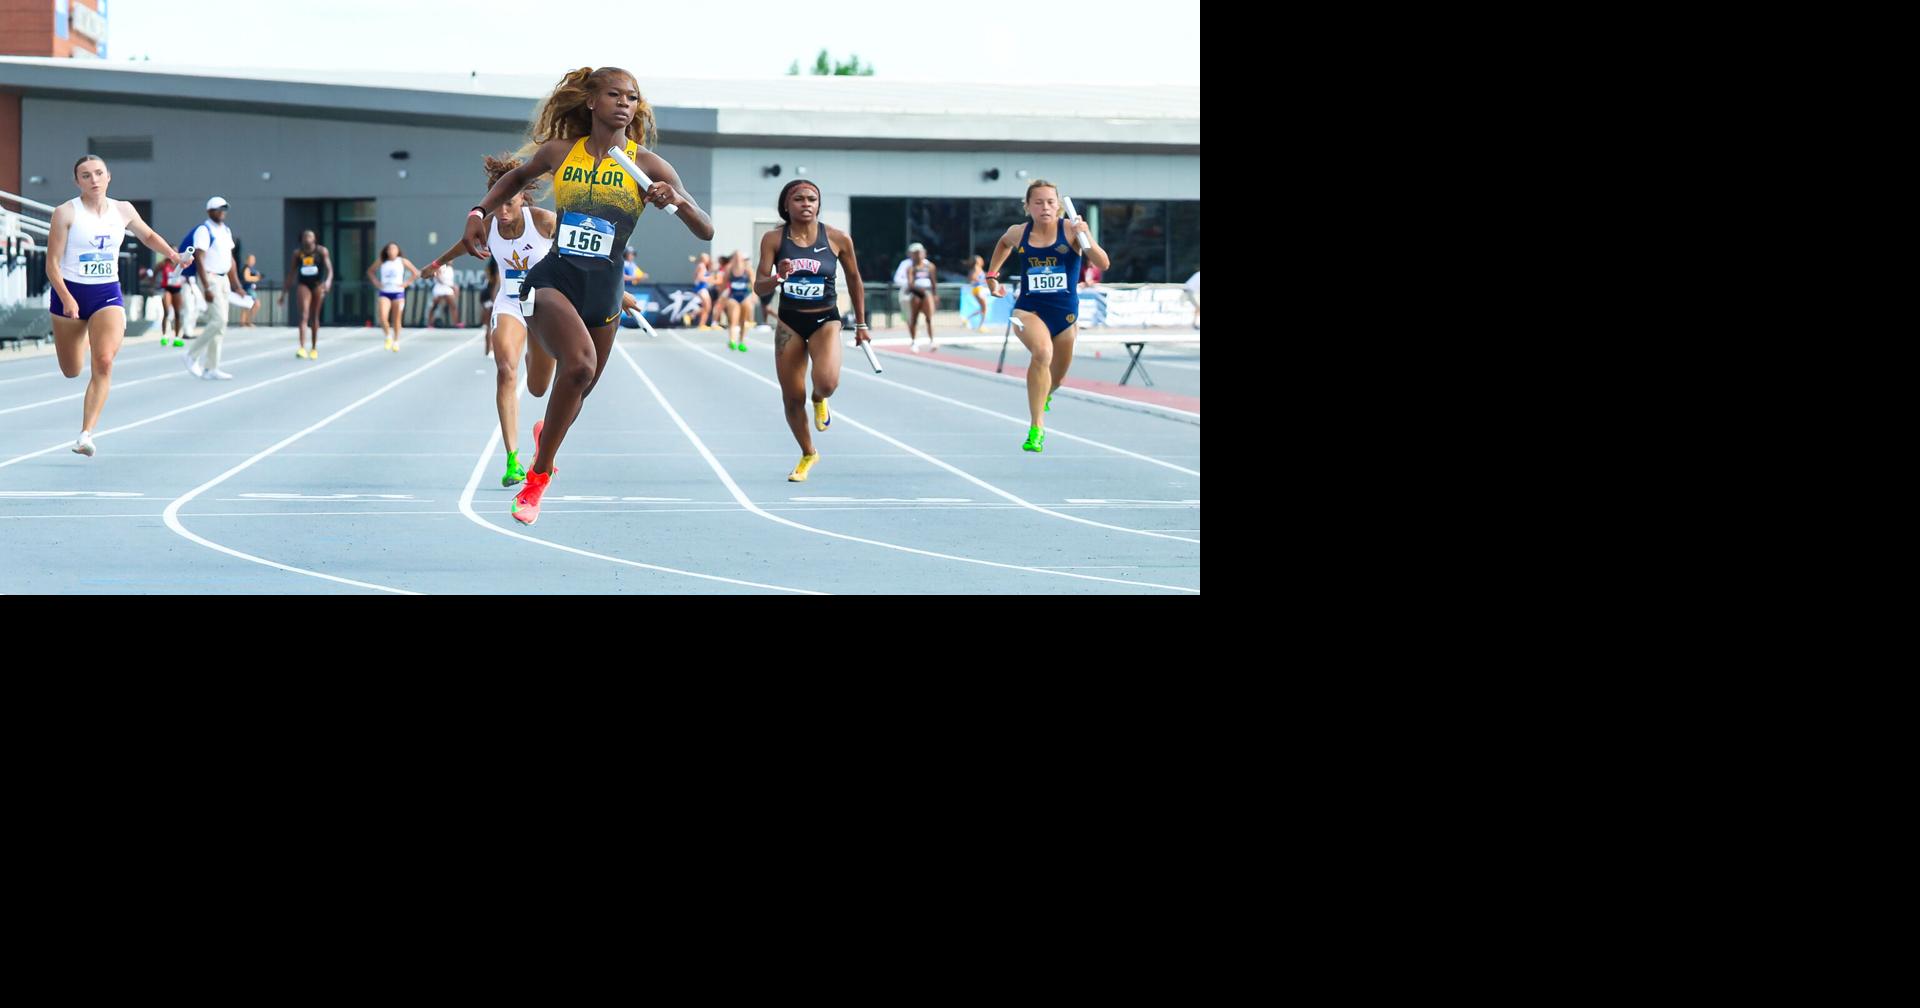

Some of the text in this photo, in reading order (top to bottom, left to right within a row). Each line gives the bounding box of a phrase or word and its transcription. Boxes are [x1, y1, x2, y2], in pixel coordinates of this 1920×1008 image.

[562, 166, 624, 188] BAYLOR
[566, 229, 603, 252] 156
[83, 263, 112, 274] 1268
[1032, 276, 1064, 289] 1502
